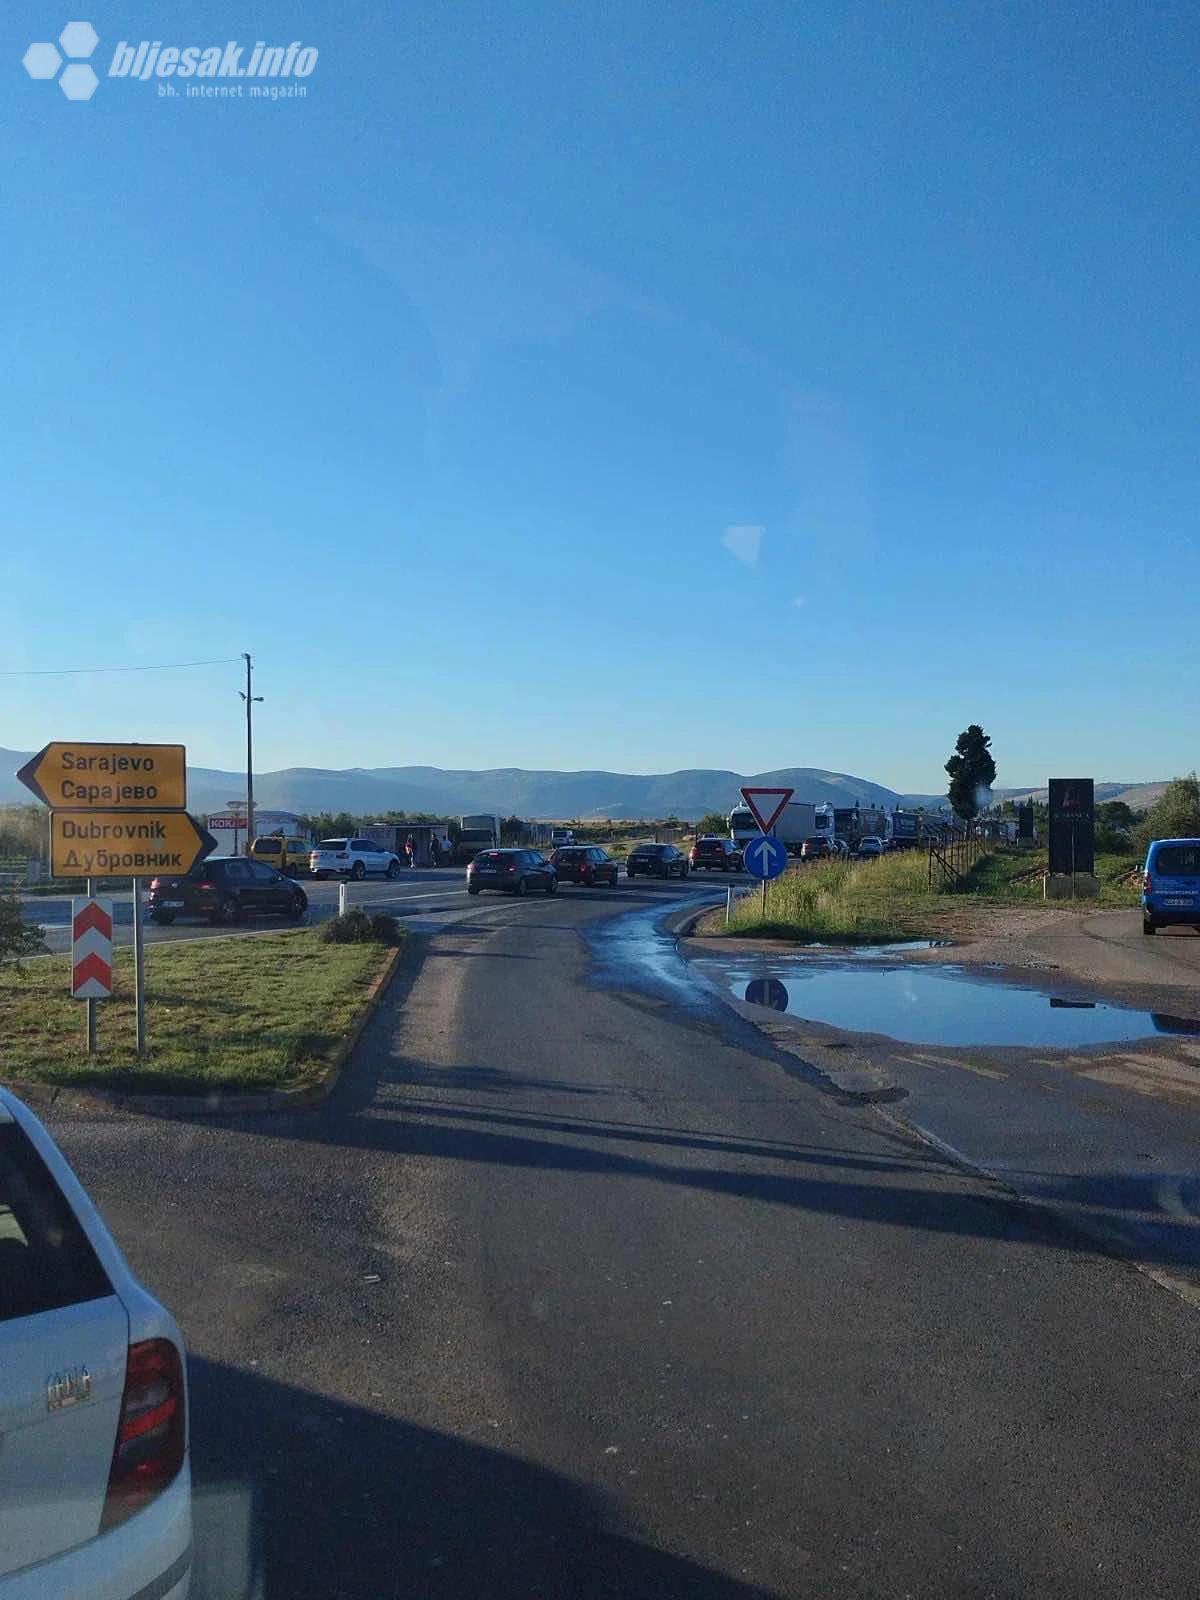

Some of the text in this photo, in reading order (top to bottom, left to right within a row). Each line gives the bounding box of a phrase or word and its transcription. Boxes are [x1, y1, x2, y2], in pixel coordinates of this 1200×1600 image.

[61, 752, 154, 775] Sarajevo
[61, 780, 158, 803] Сарајево
[62, 821, 166, 839] Dubrovnik
[63, 850, 182, 872] Дубровник
